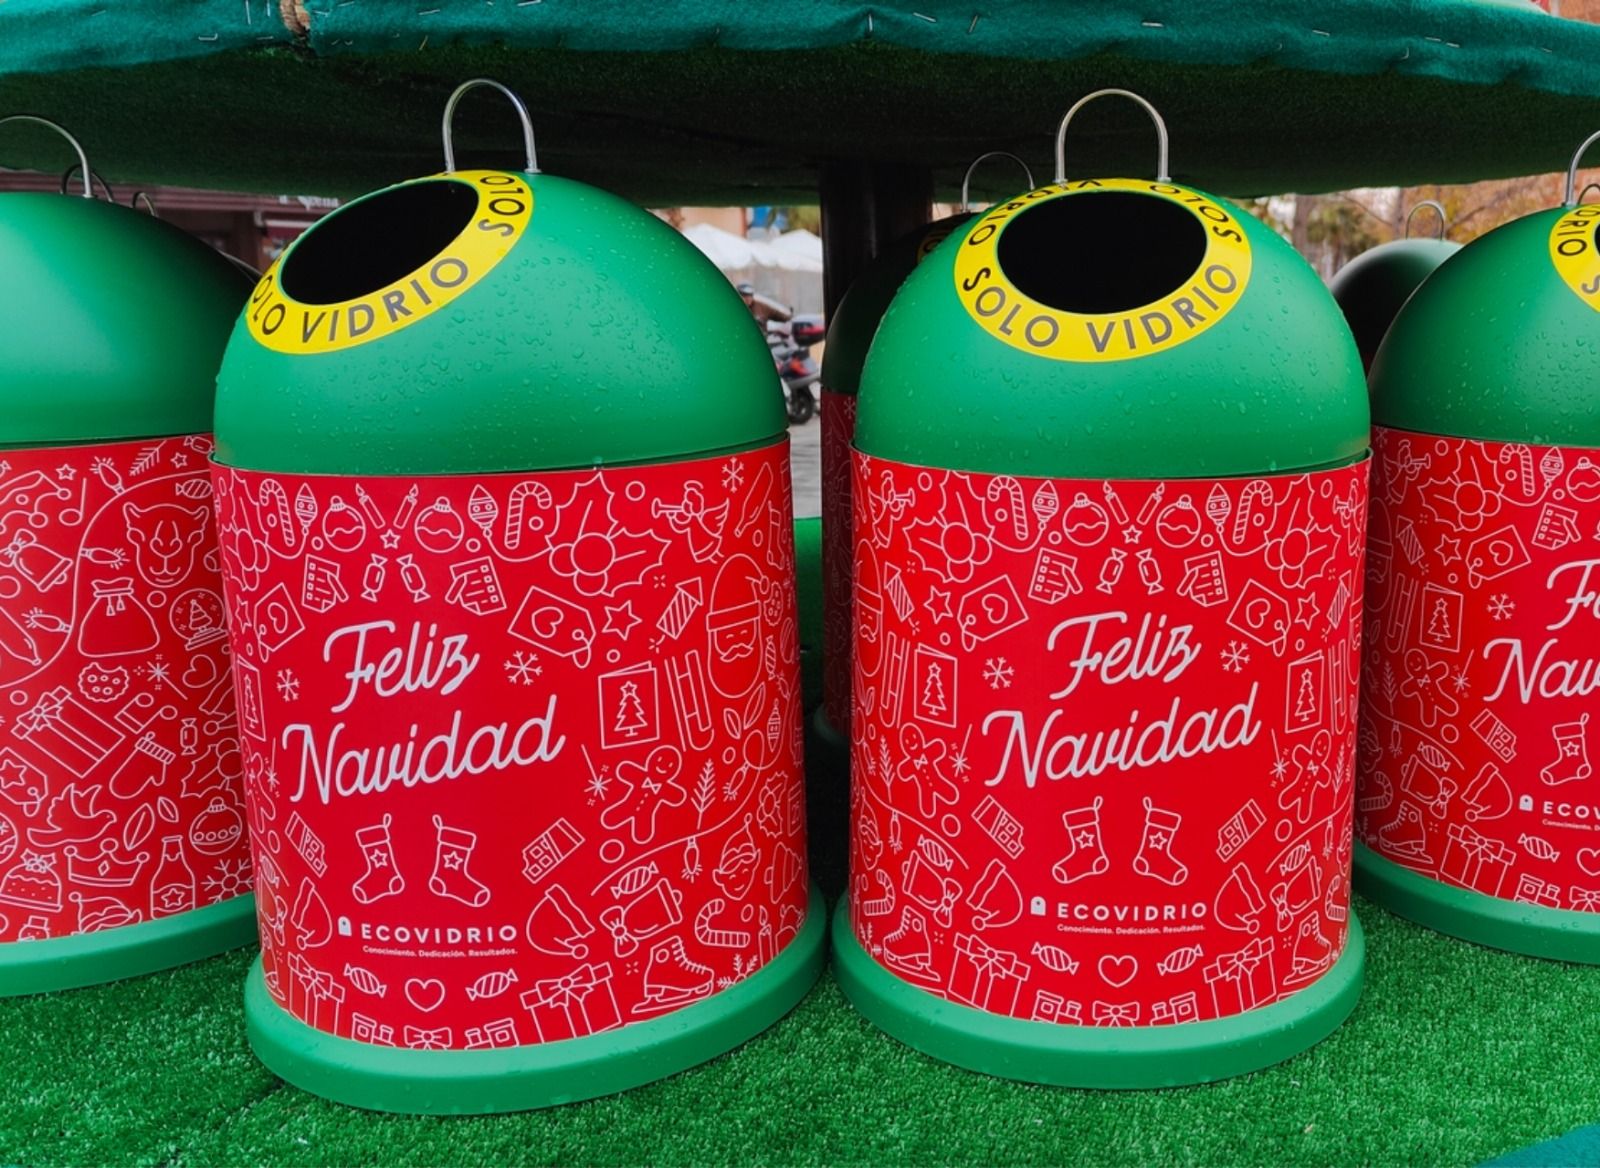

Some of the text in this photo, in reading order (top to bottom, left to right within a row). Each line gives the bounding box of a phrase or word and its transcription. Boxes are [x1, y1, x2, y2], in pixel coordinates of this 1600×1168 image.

[478, 175, 526, 237] SOLO
[1149, 184, 1242, 243] SOLO
[1557, 209, 1600, 257] DRIO
[251, 257, 469, 344] OLO VIDRIO
[962, 264, 1237, 353] SOLO VIDRIO
[323, 619, 480, 713] Feliz
[1047, 610, 1202, 700] Feliz
[282, 693, 567, 805] Navidad
[981, 680, 1263, 788] Navidad
[361, 923, 517, 944] ECOVIDRIO
[1057, 902, 1207, 921] ECOVIDRIO
